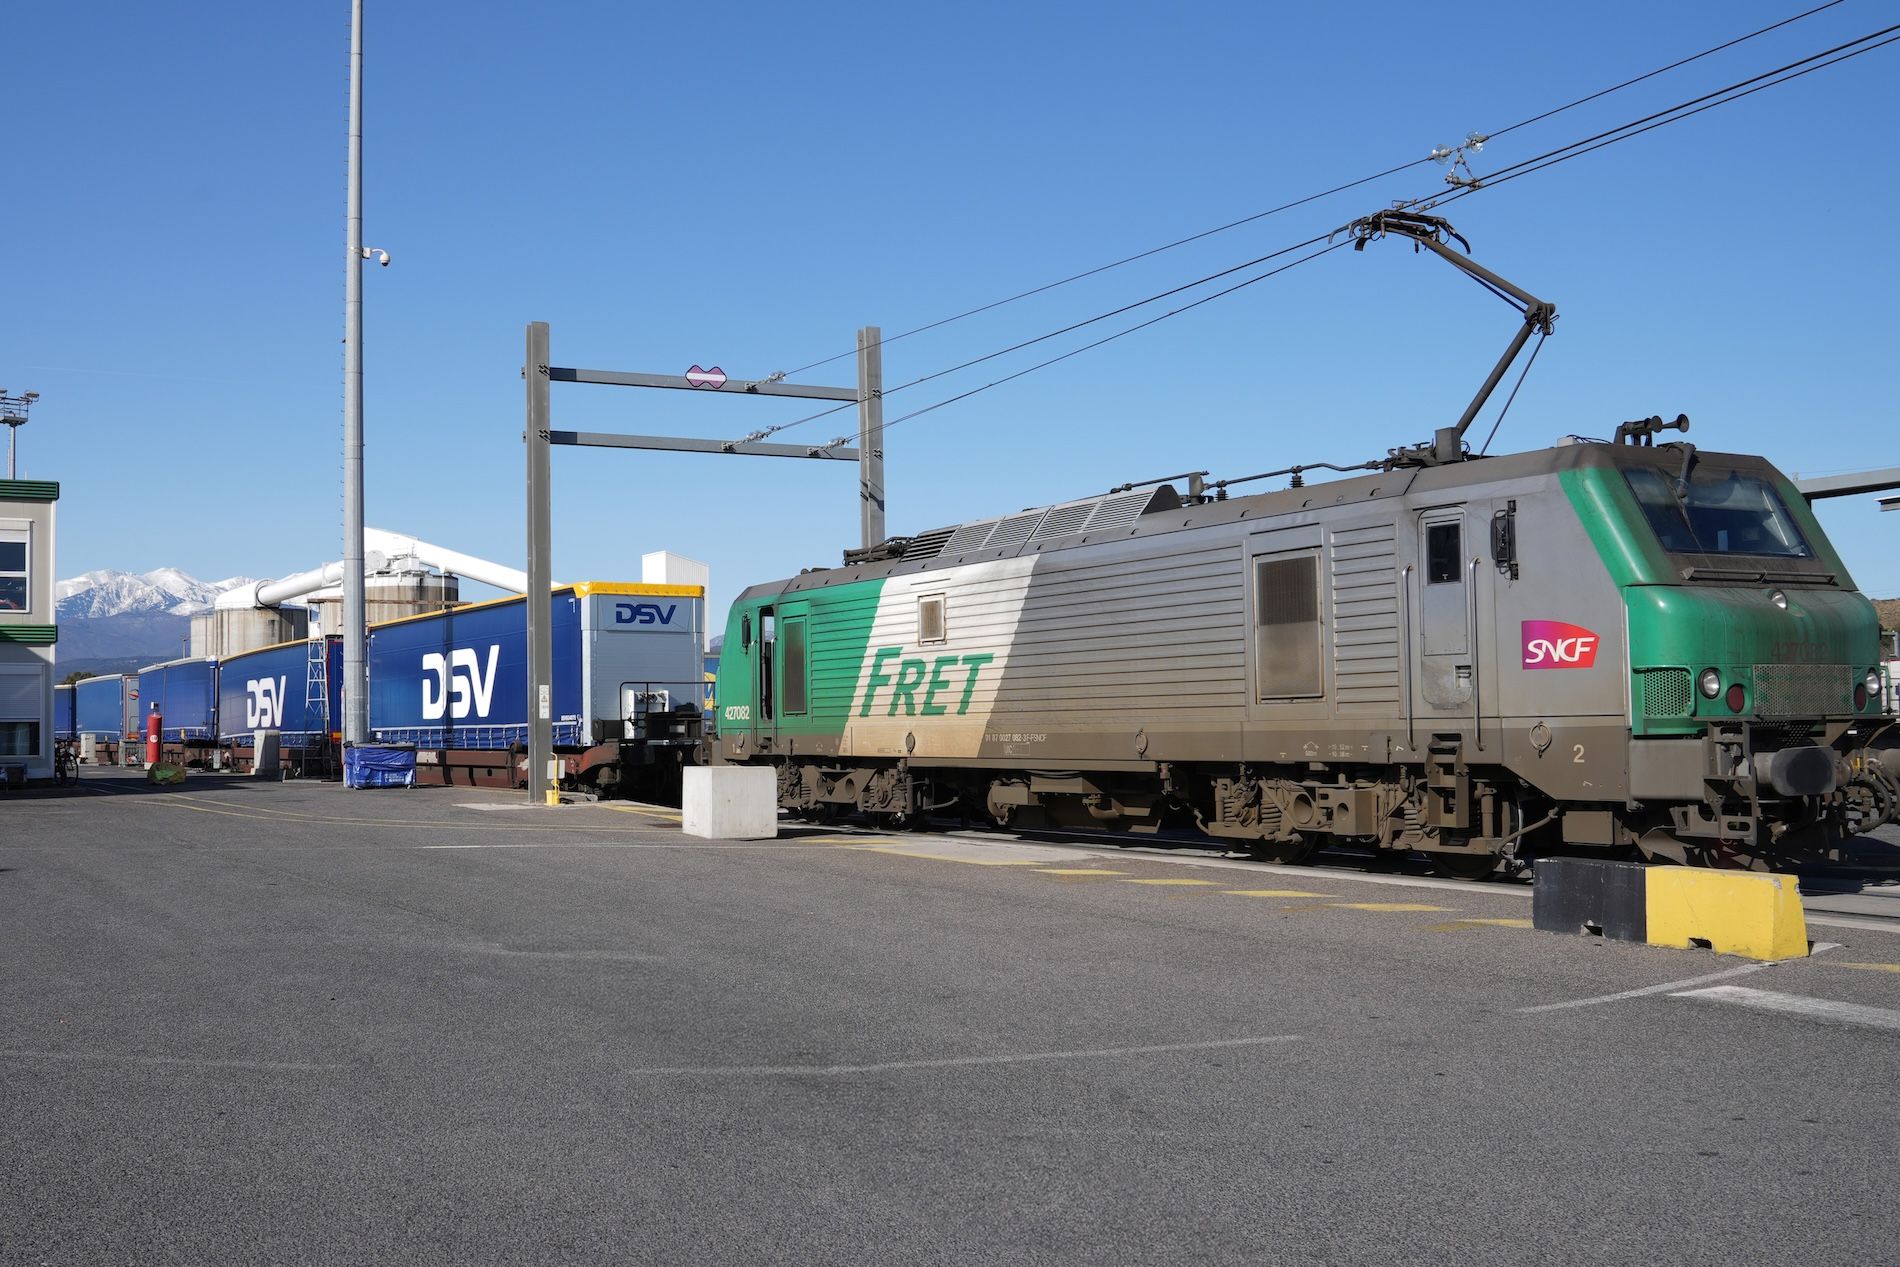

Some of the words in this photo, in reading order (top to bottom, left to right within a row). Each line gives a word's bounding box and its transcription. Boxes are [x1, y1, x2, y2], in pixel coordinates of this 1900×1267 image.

[616, 603, 677, 624] DSV
[1525, 637, 1596, 664] SNCF
[422, 644, 500, 720] DSV
[246, 675, 287, 728] DSV
[725, 705, 750, 720] 427082
[1573, 744, 1585, 763] 2
